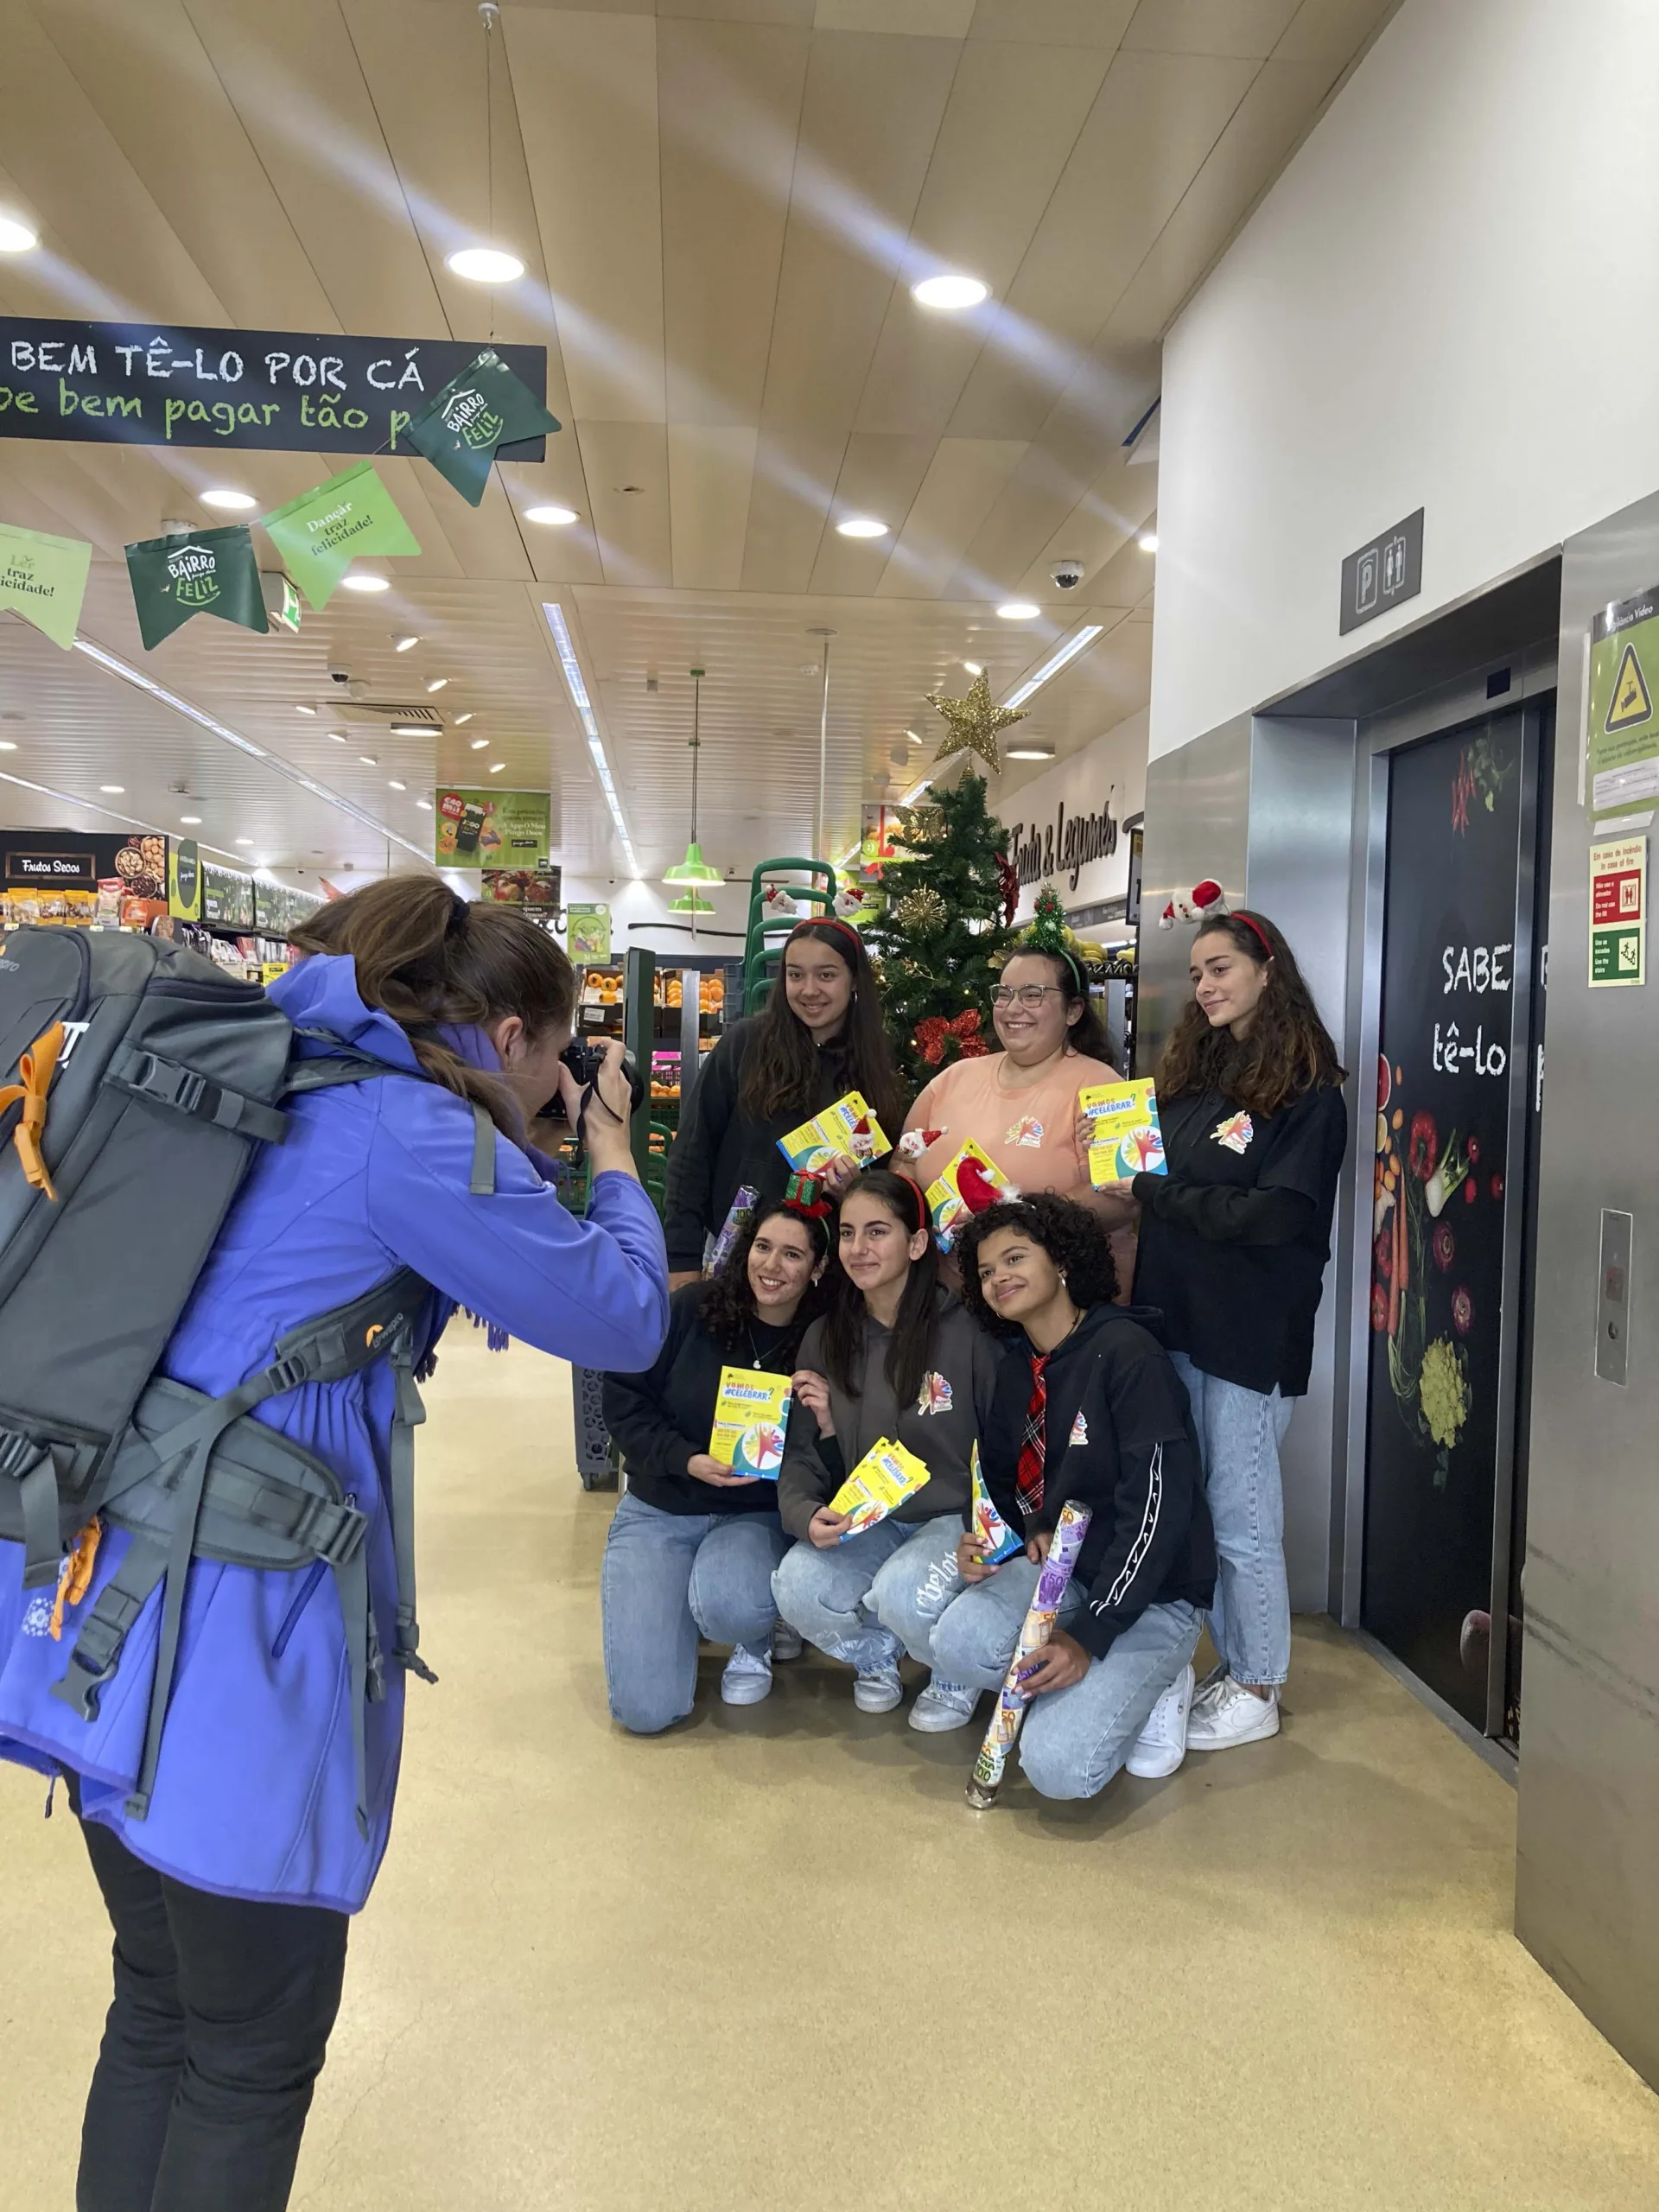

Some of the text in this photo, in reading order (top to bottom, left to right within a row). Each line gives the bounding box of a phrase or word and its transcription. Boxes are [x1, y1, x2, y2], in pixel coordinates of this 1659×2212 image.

[11, 335, 424, 391] BEM TÊ-LO POR CÁ
[59, 378, 142, 418] bem
[165, 397, 281, 440] pagar
[301, 393, 369, 429] tão
[311, 515, 373, 556] felicidade!
[324, 518, 349, 536] traz
[0, 575, 54, 597] icidade!
[7, 567, 35, 582] traz
[53, 860, 80, 874] Secos
[1043, 824, 1054, 878] &
[1442, 944, 1512, 994] SABE
[1433, 1020, 1506, 1077] tê-lo
